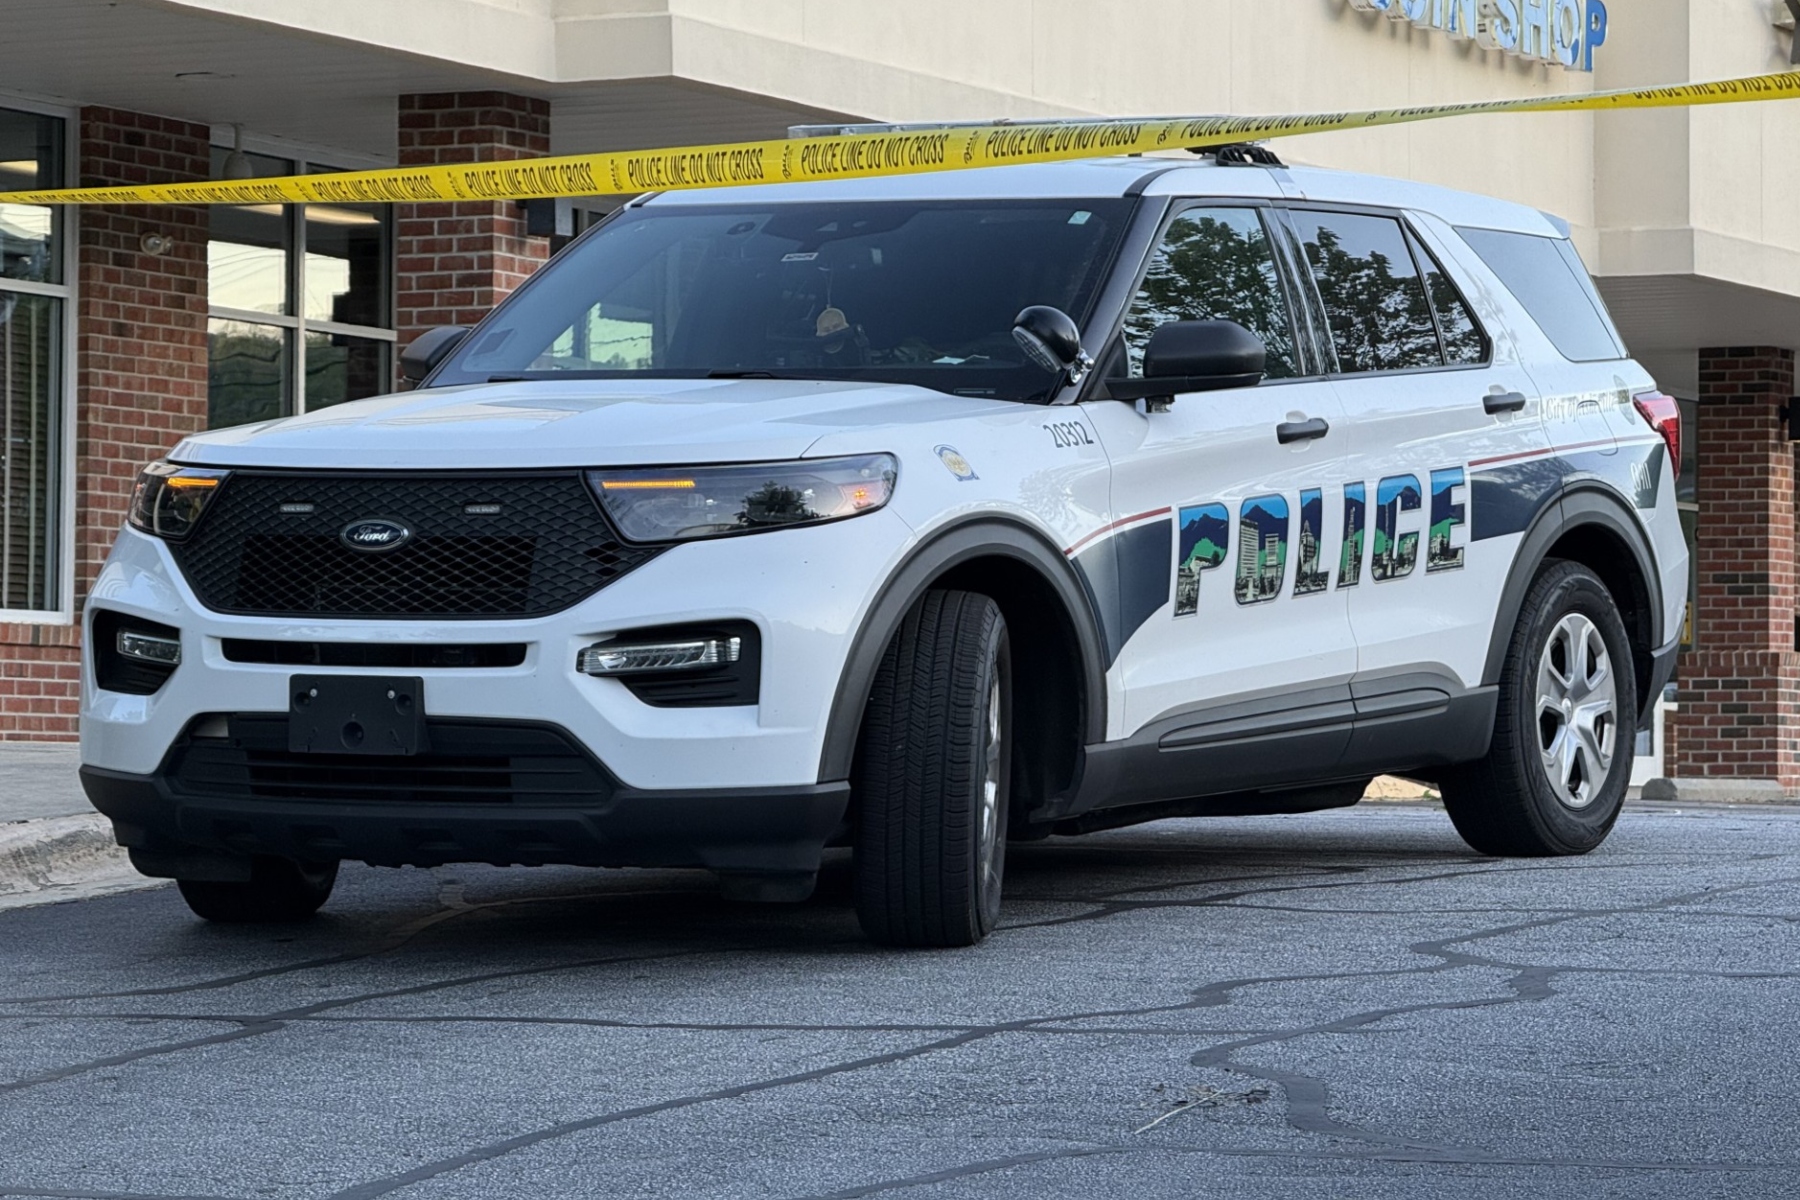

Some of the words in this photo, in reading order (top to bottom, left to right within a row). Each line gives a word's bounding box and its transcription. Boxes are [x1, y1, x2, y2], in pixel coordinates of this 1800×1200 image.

[801, 142, 840, 175] POLICE
[840, 140, 867, 171] LINE
[866, 138, 884, 169] DO
[884, 136, 910, 168] NOT
[908, 133, 949, 166] CROSS
[985, 128, 1032, 158] POLICE
[1027, 126, 1059, 154] LINE
[1054, 125, 1077, 152] DO
[1073, 124, 1101, 150] NOT
[465, 170, 506, 197] POLICE
[499, 168, 528, 196] LINE
[522, 167, 544, 195] DO
[538, 165, 563, 194] NOT
[560, 162, 598, 193] CROSS
[628, 157, 666, 188] POLICE
[665, 155, 690, 185] LINE
[689, 153, 706, 183] DO
[706, 151, 728, 183] NOT
[729, 148, 764, 181] CROSS
[312, 181, 349, 201] POLICE
[344, 180, 375, 201] LINE
[366, 178, 390, 201] DO
[380, 177, 406, 201] NOT
[402, 175, 442, 200] CROSS
[1043, 421, 1094, 448] 20312
[353, 525, 391, 541] Ford
[1173, 465, 1466, 619] POLICE
